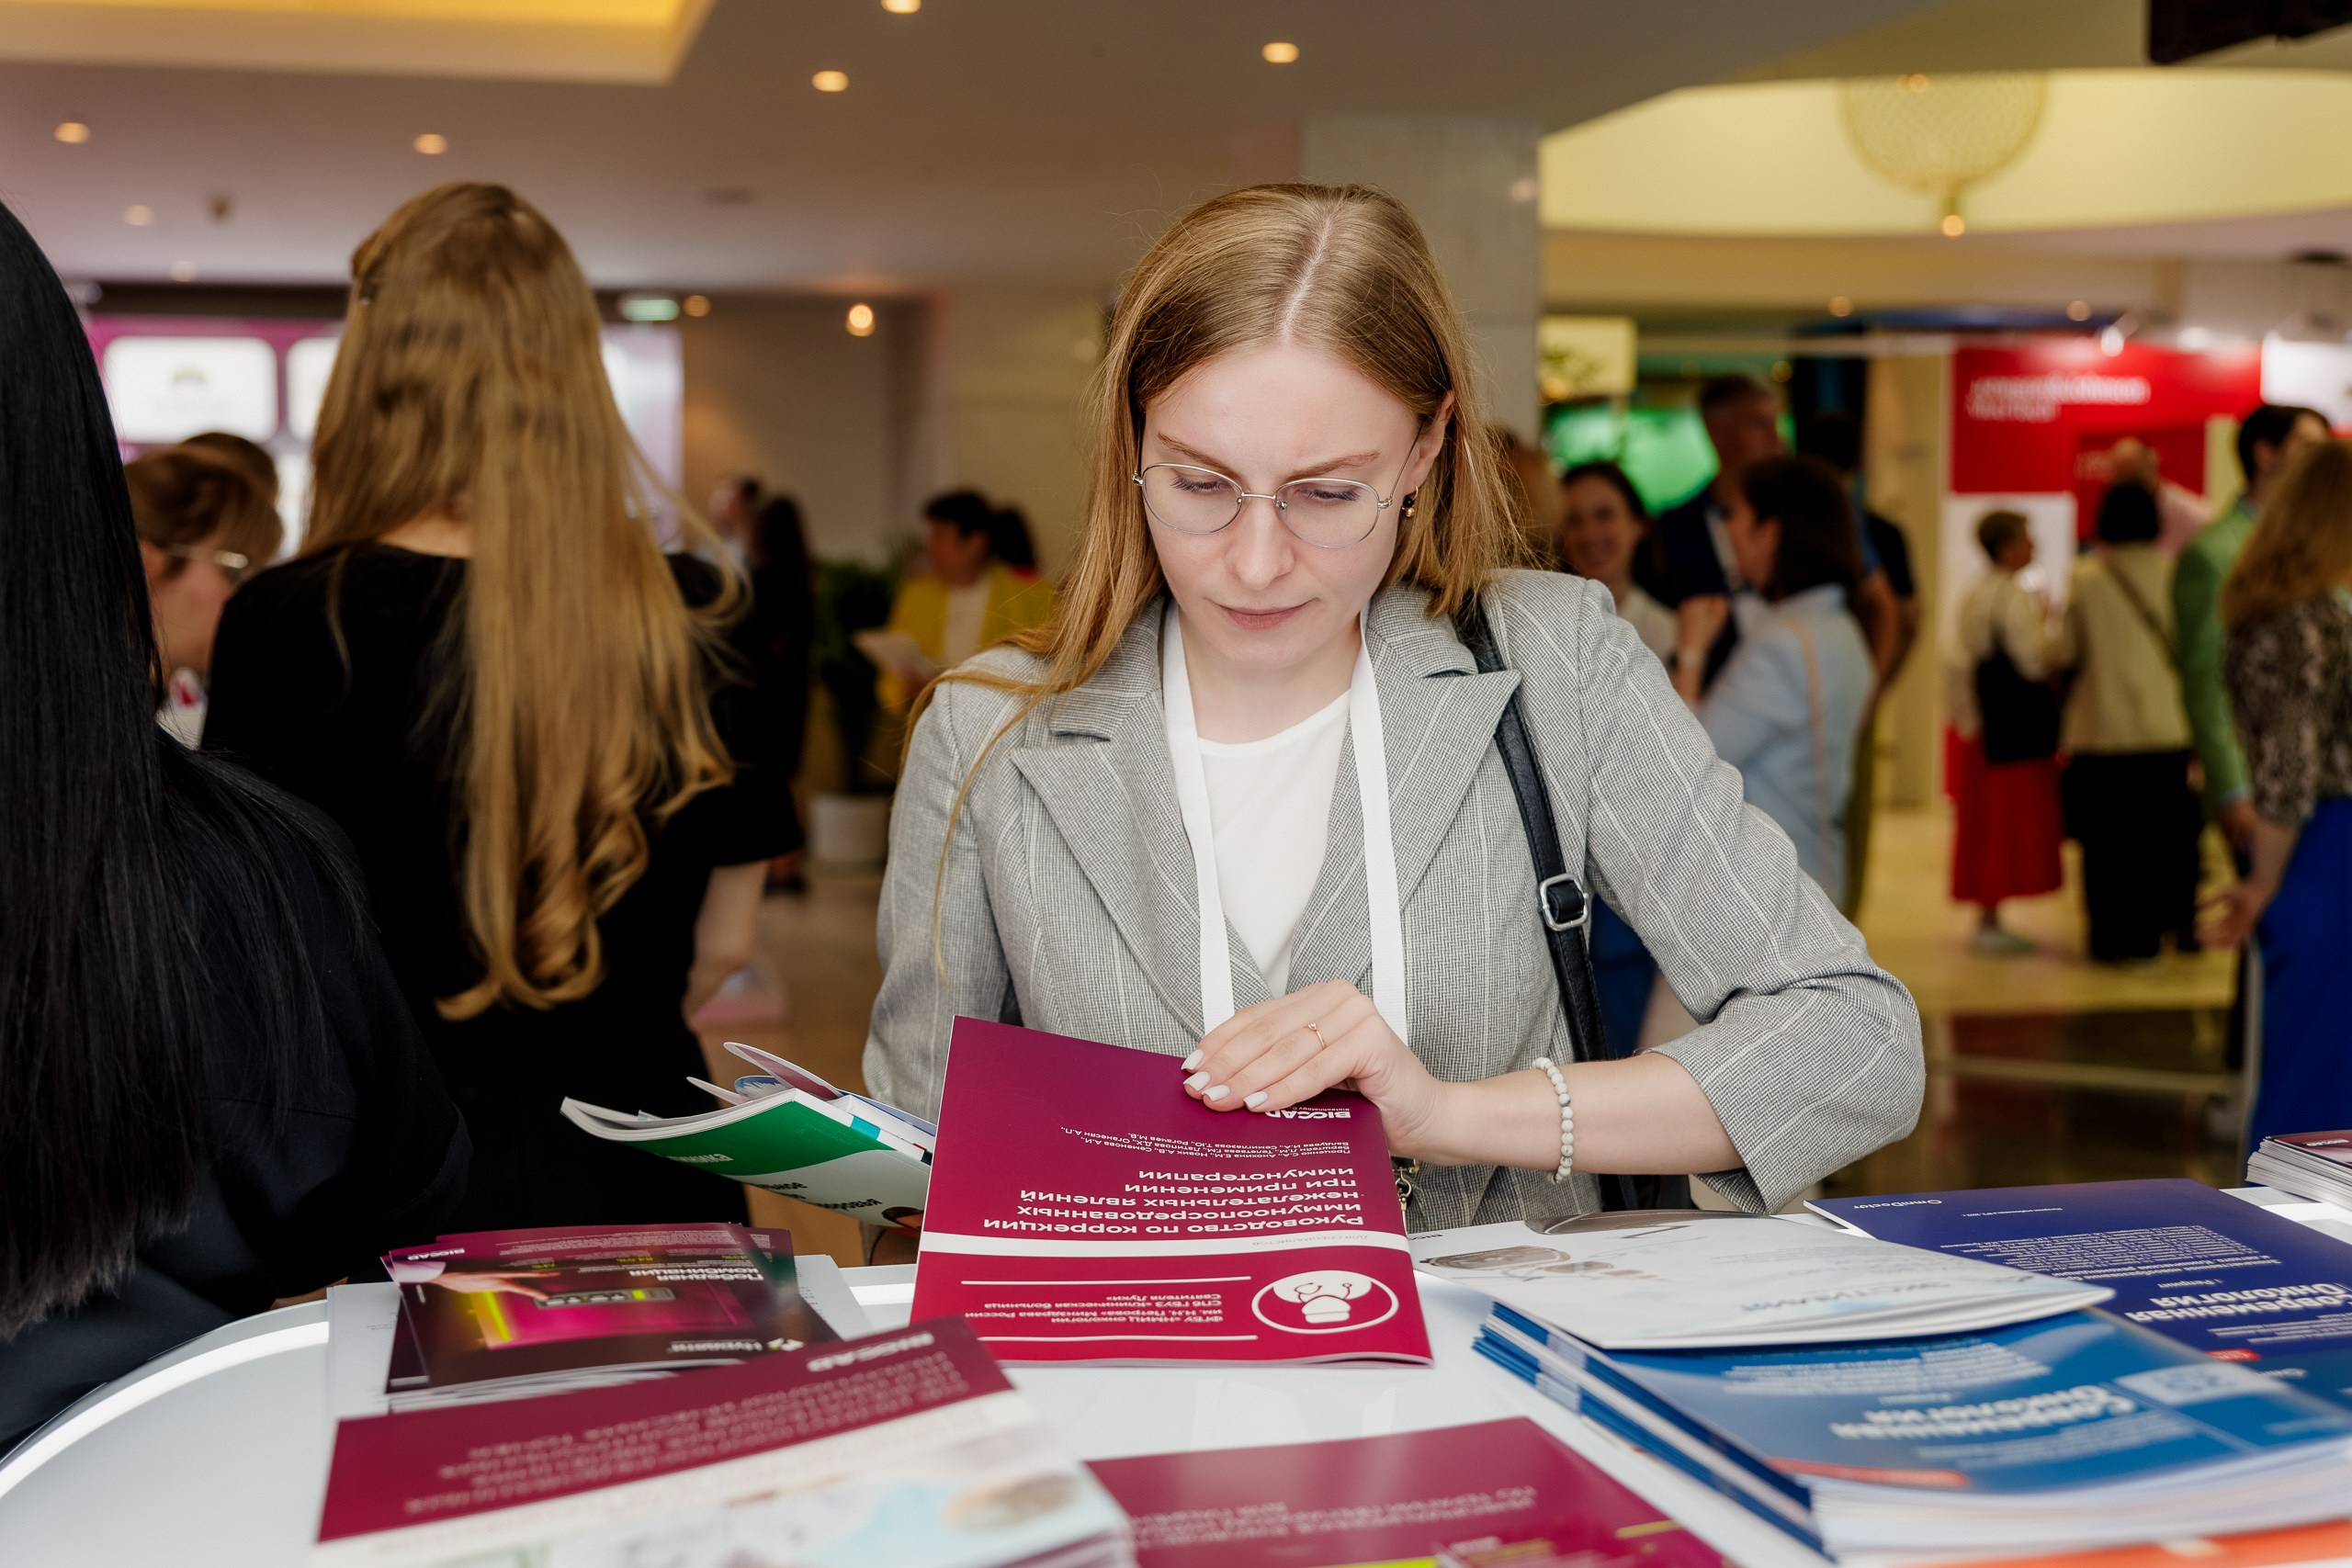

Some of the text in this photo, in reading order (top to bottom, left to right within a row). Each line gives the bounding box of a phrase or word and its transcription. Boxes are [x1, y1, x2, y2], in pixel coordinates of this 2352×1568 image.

[1264, 1110, 1351, 1120] BIOCAD
[1083, 1131, 1130, 1144] Оганесян
[1149, 1135, 1189, 1146] Рогачев
[1103, 1141, 1152, 1153] Семенова
[1154, 1142, 1201, 1152] Латипова
[1138, 1168, 1354, 1181] иммунотерапии
[1125, 1178, 1356, 1194] при применении
[1020, 1190, 1359, 1207] нежелательных явлений
[1853, 1199, 1942, 1209] OmniDoctor
[1016, 1203, 1362, 1221] иммуноопосредованных
[983, 1213, 1364, 1234] Руководство по коррекции
[629, 1268, 759, 1277] комбинация
[656, 1273, 764, 1281] Победная
[1150, 1293, 1222, 1302] Святителя
[2149, 1282, 2344, 1308] Онкология
[984, 1302, 1052, 1310] больница
[1051, 1315, 1125, 1324] онкологии
